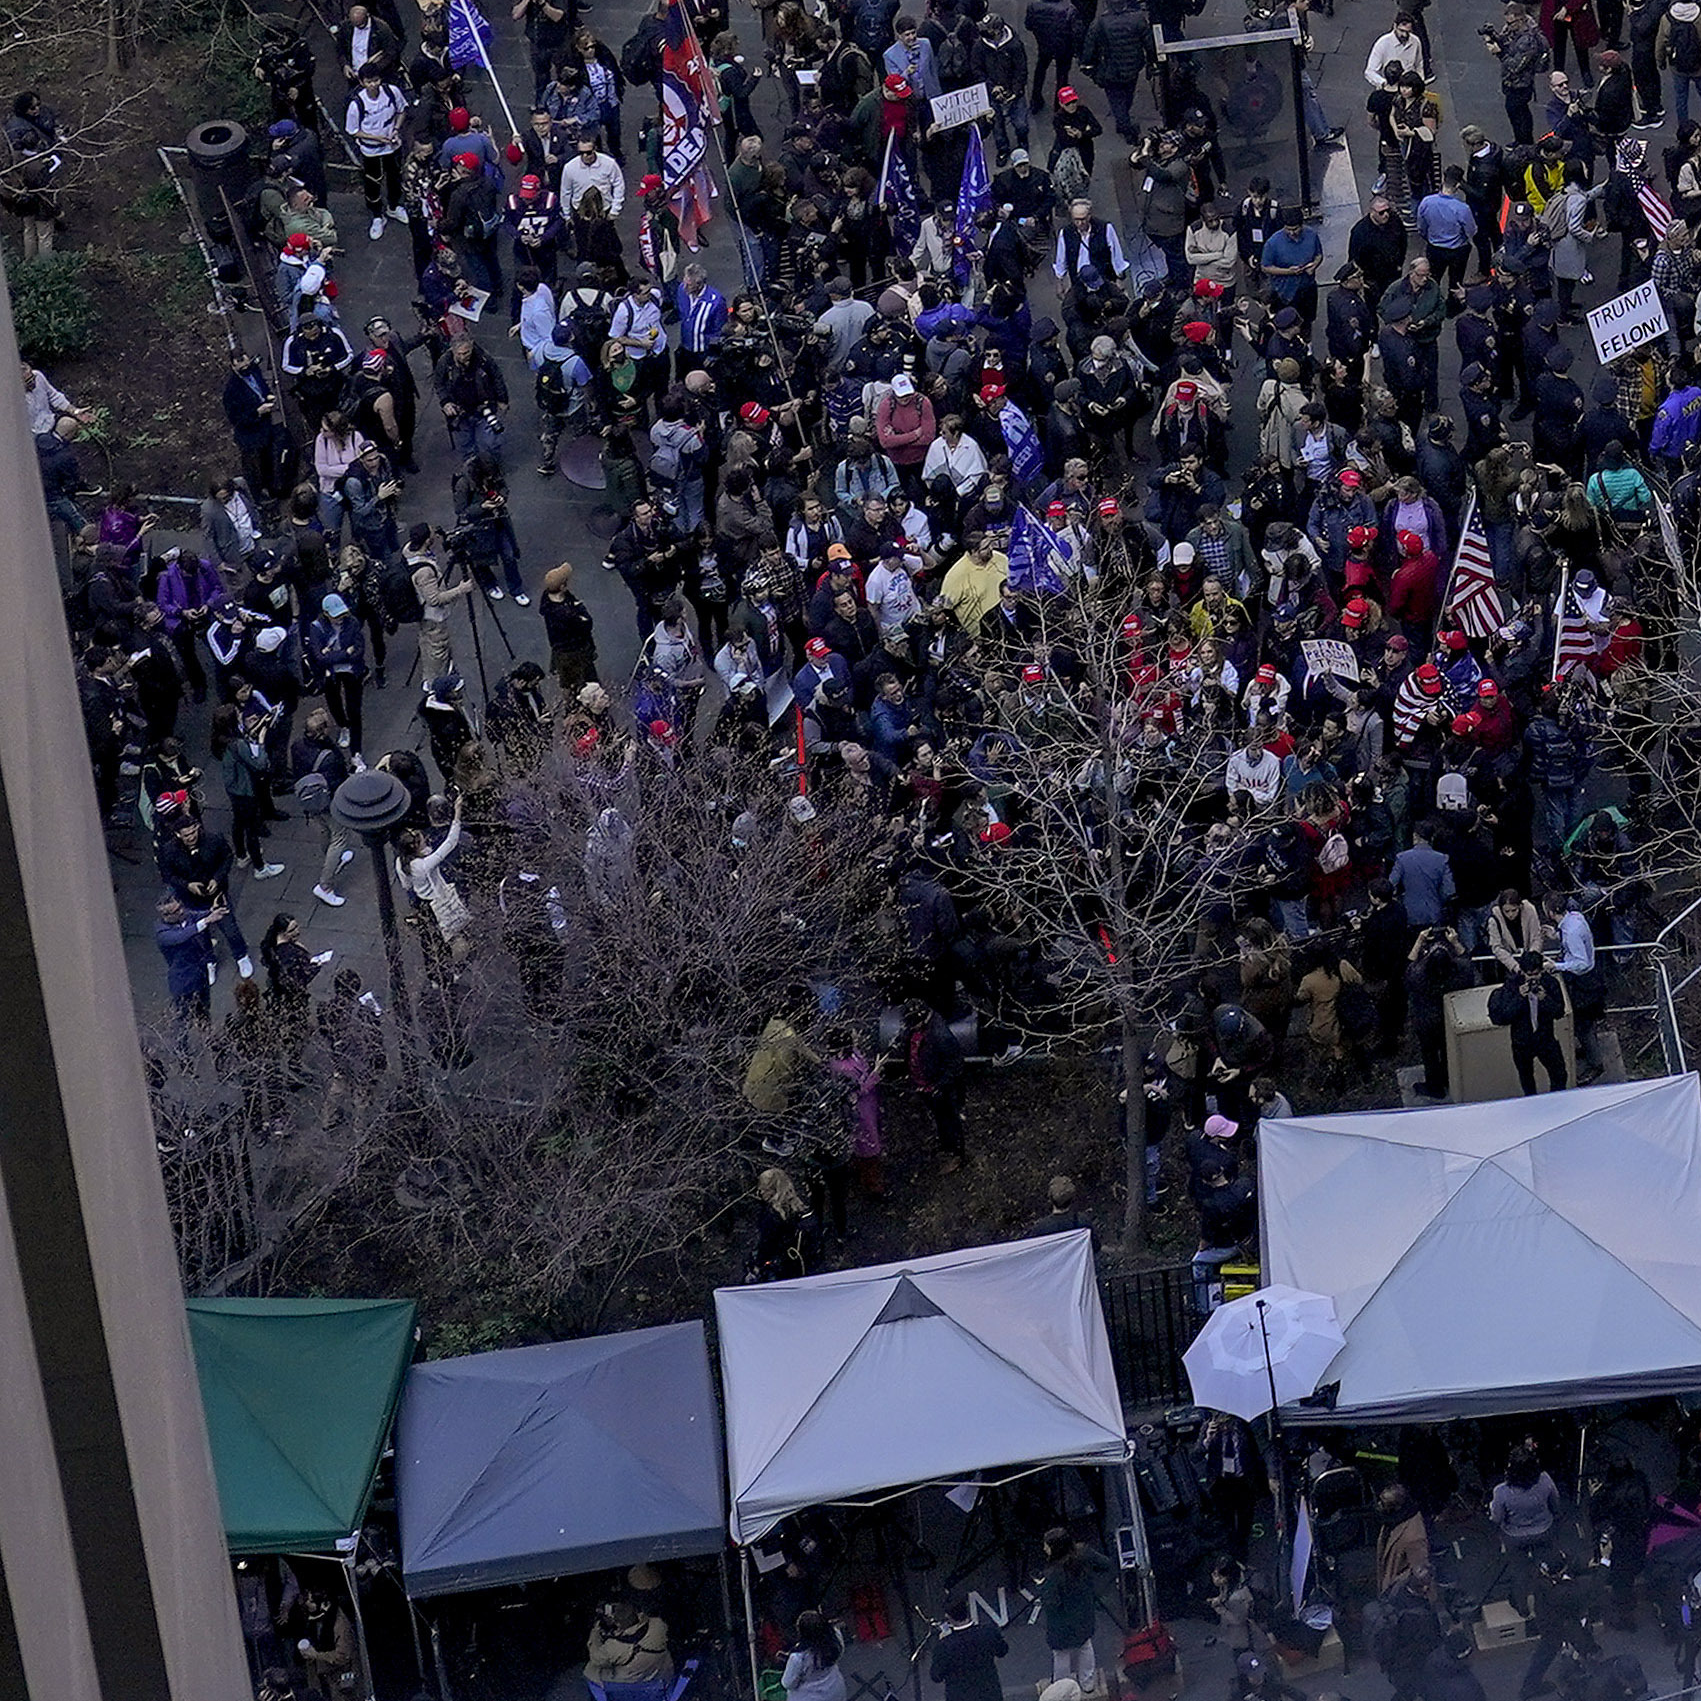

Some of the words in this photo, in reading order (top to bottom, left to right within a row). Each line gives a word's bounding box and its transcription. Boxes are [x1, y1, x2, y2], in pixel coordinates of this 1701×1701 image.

[935, 89, 980, 112] WITCH
[943, 102, 981, 126] HUNT
[1590, 286, 1652, 329] TRUMP
[1600, 315, 1665, 359] FELONY
